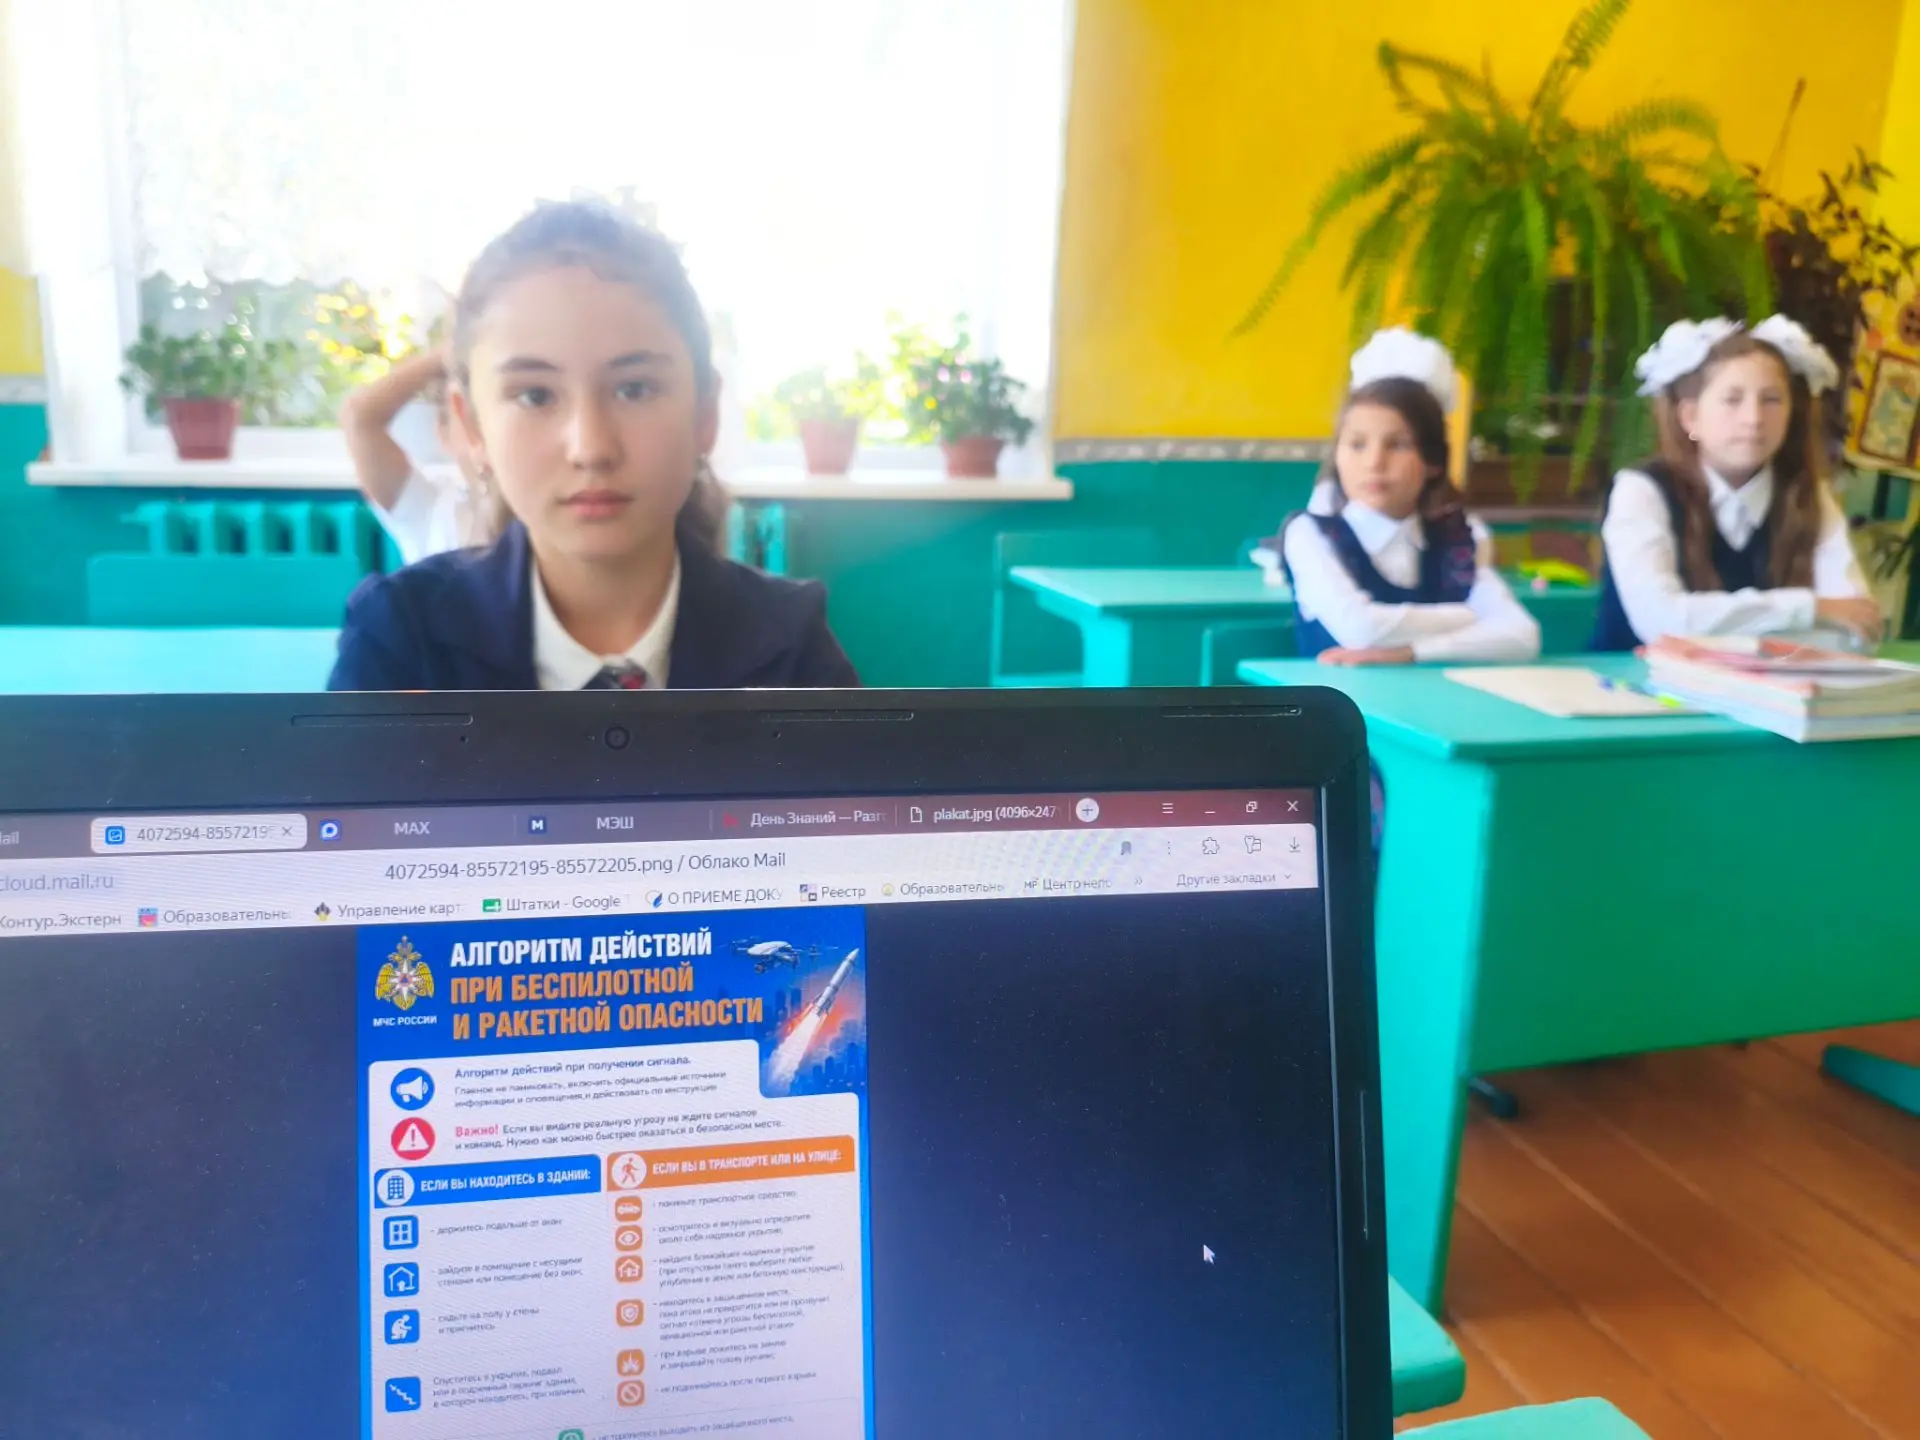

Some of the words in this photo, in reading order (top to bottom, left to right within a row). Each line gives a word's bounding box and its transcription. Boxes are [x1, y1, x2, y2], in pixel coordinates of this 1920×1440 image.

[596, 816, 635, 830] МЭШ
[751, 812, 785, 828] День
[787, 810, 836, 825] Знаний
[933, 808, 993, 824] plakat.jpg
[394, 821, 431, 836] MAX
[0, 831, 20, 846] ail
[385, 857, 673, 880] 4072594-85572195-85572205.png
[688, 854, 750, 870] Облако
[754, 852, 786, 869] Mail
[1043, 878, 1082, 892] Центр
[1176, 874, 1220, 888] Другие
[1223, 872, 1276, 885] закладки
[667, 892, 680, 906] О
[683, 889, 743, 905] ПРИЕМЕ
[821, 886, 867, 900] Реестр
[338, 903, 426, 920] Управление
[506, 897, 560, 912] Штатки
[572, 895, 621, 913] Google
[450, 937, 582, 967] АЛГОРИТМ
[589, 926, 712, 965] ДЕЙСТВИЙ
[451, 976, 503, 1004] ПРИ
[511, 960, 694, 1002] БЕСПИЛОТНОЙ
[373, 1016, 396, 1028] МЧС
[397, 1015, 438, 1026] РОССИИ
[453, 1013, 470, 1040] И
[479, 1000, 611, 1039] РАКЕТНОЙ
[619, 997, 763, 1031] ОПАСНОСТИ
[455, 1068, 509, 1079] Алгоритм
[511, 1063, 562, 1076] действий
[565, 1063, 585, 1073] при
[588, 1060, 644, 1071] получении
[647, 1057, 691, 1067] сигнала.
[455, 1086, 494, 1095] Главное
[567, 1079, 613, 1088] включить
[615, 1074, 678, 1086] официальные
[680, 1072, 726, 1080] источники
[455, 1097, 516, 1108] информации
[592, 1089, 649, 1099] действовать
[651, 1088, 663, 1096] по
[665, 1084, 717, 1094] инструкции
[455, 1124, 499, 1138] Важно!
[503, 1125, 527, 1134] Если
[546, 1122, 582, 1131] видите
[583, 1118, 632, 1129] реальную
[634, 1115, 666, 1127] угрозу
[681, 1112, 712, 1122] ждите
[714, 1109, 757, 1119] сигналов
[506, 1136, 539, 1148] Нужно
[542, 1136, 558, 1144] как
[561, 1133, 594, 1143] можно
[596, 1130, 637, 1141] быстрее
[639, 1127, 687, 1137] оказаться
[696, 1121, 752, 1133] безопасном
[652, 1162, 680, 1175] ЕСЛИ
[681, 1161, 697, 1173] ВЫ
[699, 1160, 706, 1172] В
[709, 1156, 768, 1170] ТРАНСПОРТЕ
[771, 1155, 790, 1165] ИЛИ
[793, 1153, 806, 1164] НА
[808, 1149, 842, 1163] УЛИЦЕ:
[421, 1179, 449, 1192] ЕСЛИ
[451, 1177, 467, 1190] ВЫ
[470, 1173, 535, 1188] НАХОДИТЕСЬ
[537, 1171, 544, 1183] В
[546, 1168, 592, 1183] ЗДАНИИ:
[698, 1193, 755, 1206] транспортное
[437, 1225, 483, 1235] держитесь
[486, 1220, 528, 1231] подальше
